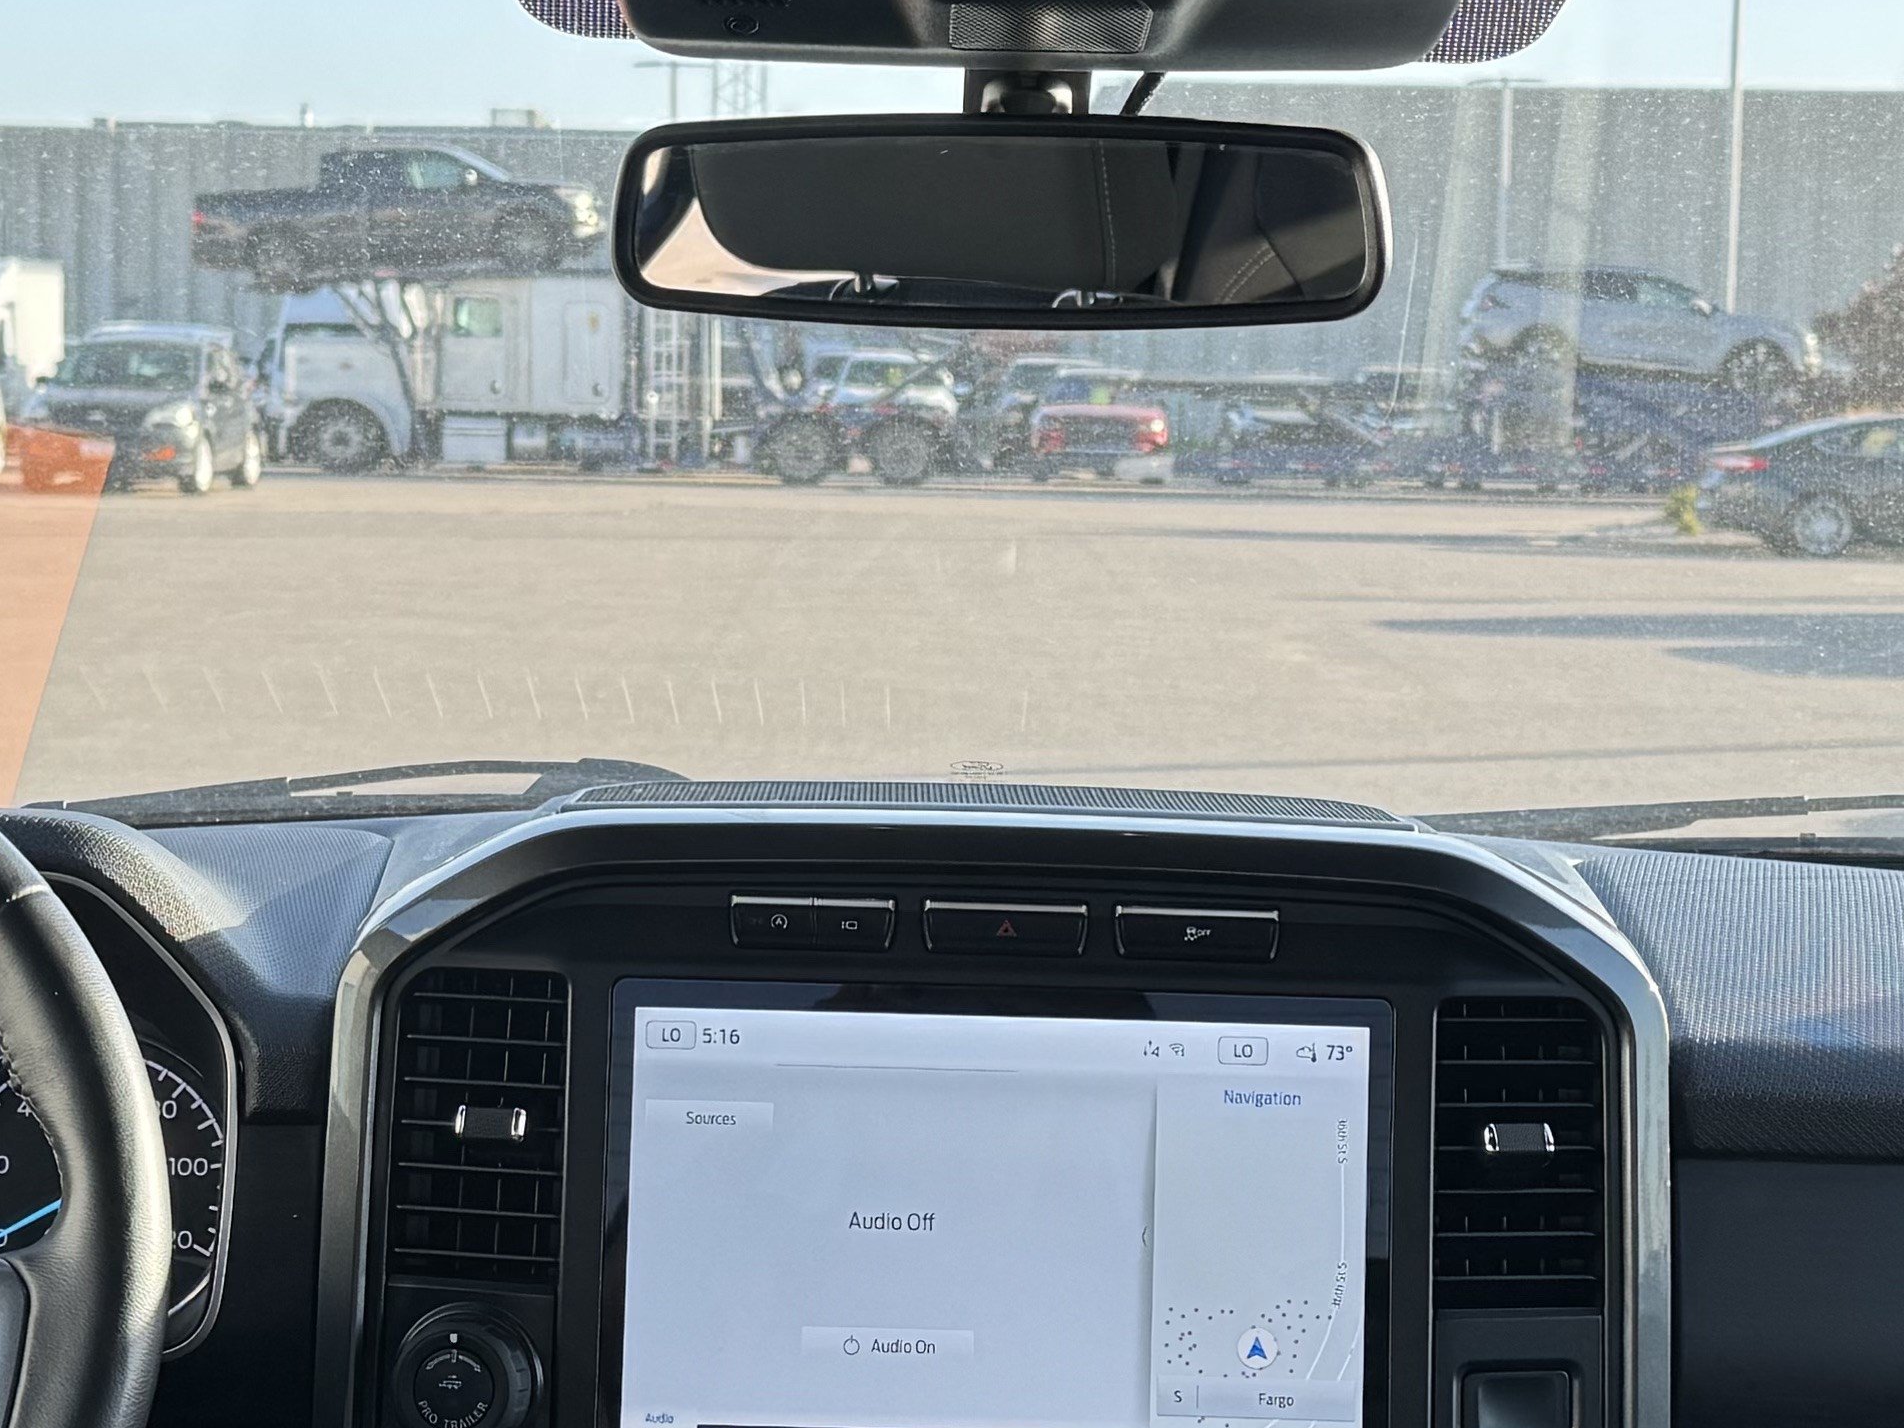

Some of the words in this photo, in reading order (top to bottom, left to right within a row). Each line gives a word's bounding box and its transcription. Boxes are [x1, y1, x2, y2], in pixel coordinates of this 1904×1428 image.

[661, 1027, 682, 1043] LO
[702, 1028, 741, 1045] 5:16
[1233, 1044, 1253, 1058] LO
[1326, 1044, 1353, 1061] 73°
[1224, 1090, 1301, 1107] Navigation
[686, 1111, 737, 1126] Sources
[168, 1157, 208, 1176] 100
[848, 1211, 902, 1231] Audio
[907, 1212, 936, 1232] Off
[871, 1338, 912, 1354] Audio
[915, 1339, 936, 1355] On
[1173, 1390, 1182, 1403] S
[1258, 1392, 1294, 1409] Fargo
[417, 1400, 438, 1425] PRO
[645, 1413, 674, 1424] Audio
